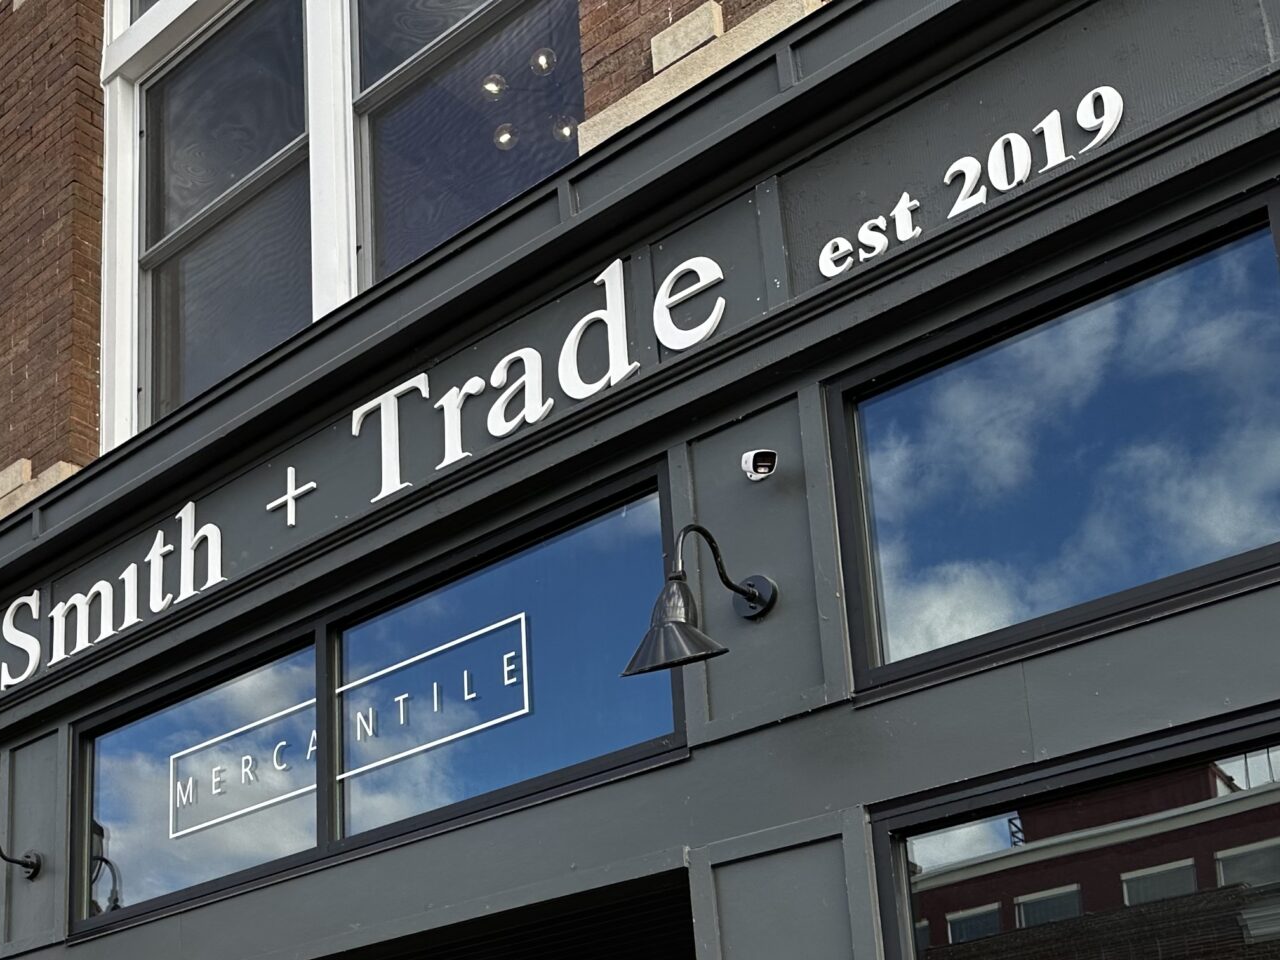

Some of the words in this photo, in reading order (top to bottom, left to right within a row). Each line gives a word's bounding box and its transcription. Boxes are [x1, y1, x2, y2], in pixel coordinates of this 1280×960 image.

[818, 191, 922, 278] est
[943, 85, 1124, 219] 2019
[0, 501, 228, 691] Smith
[351, 256, 726, 503] Trade
